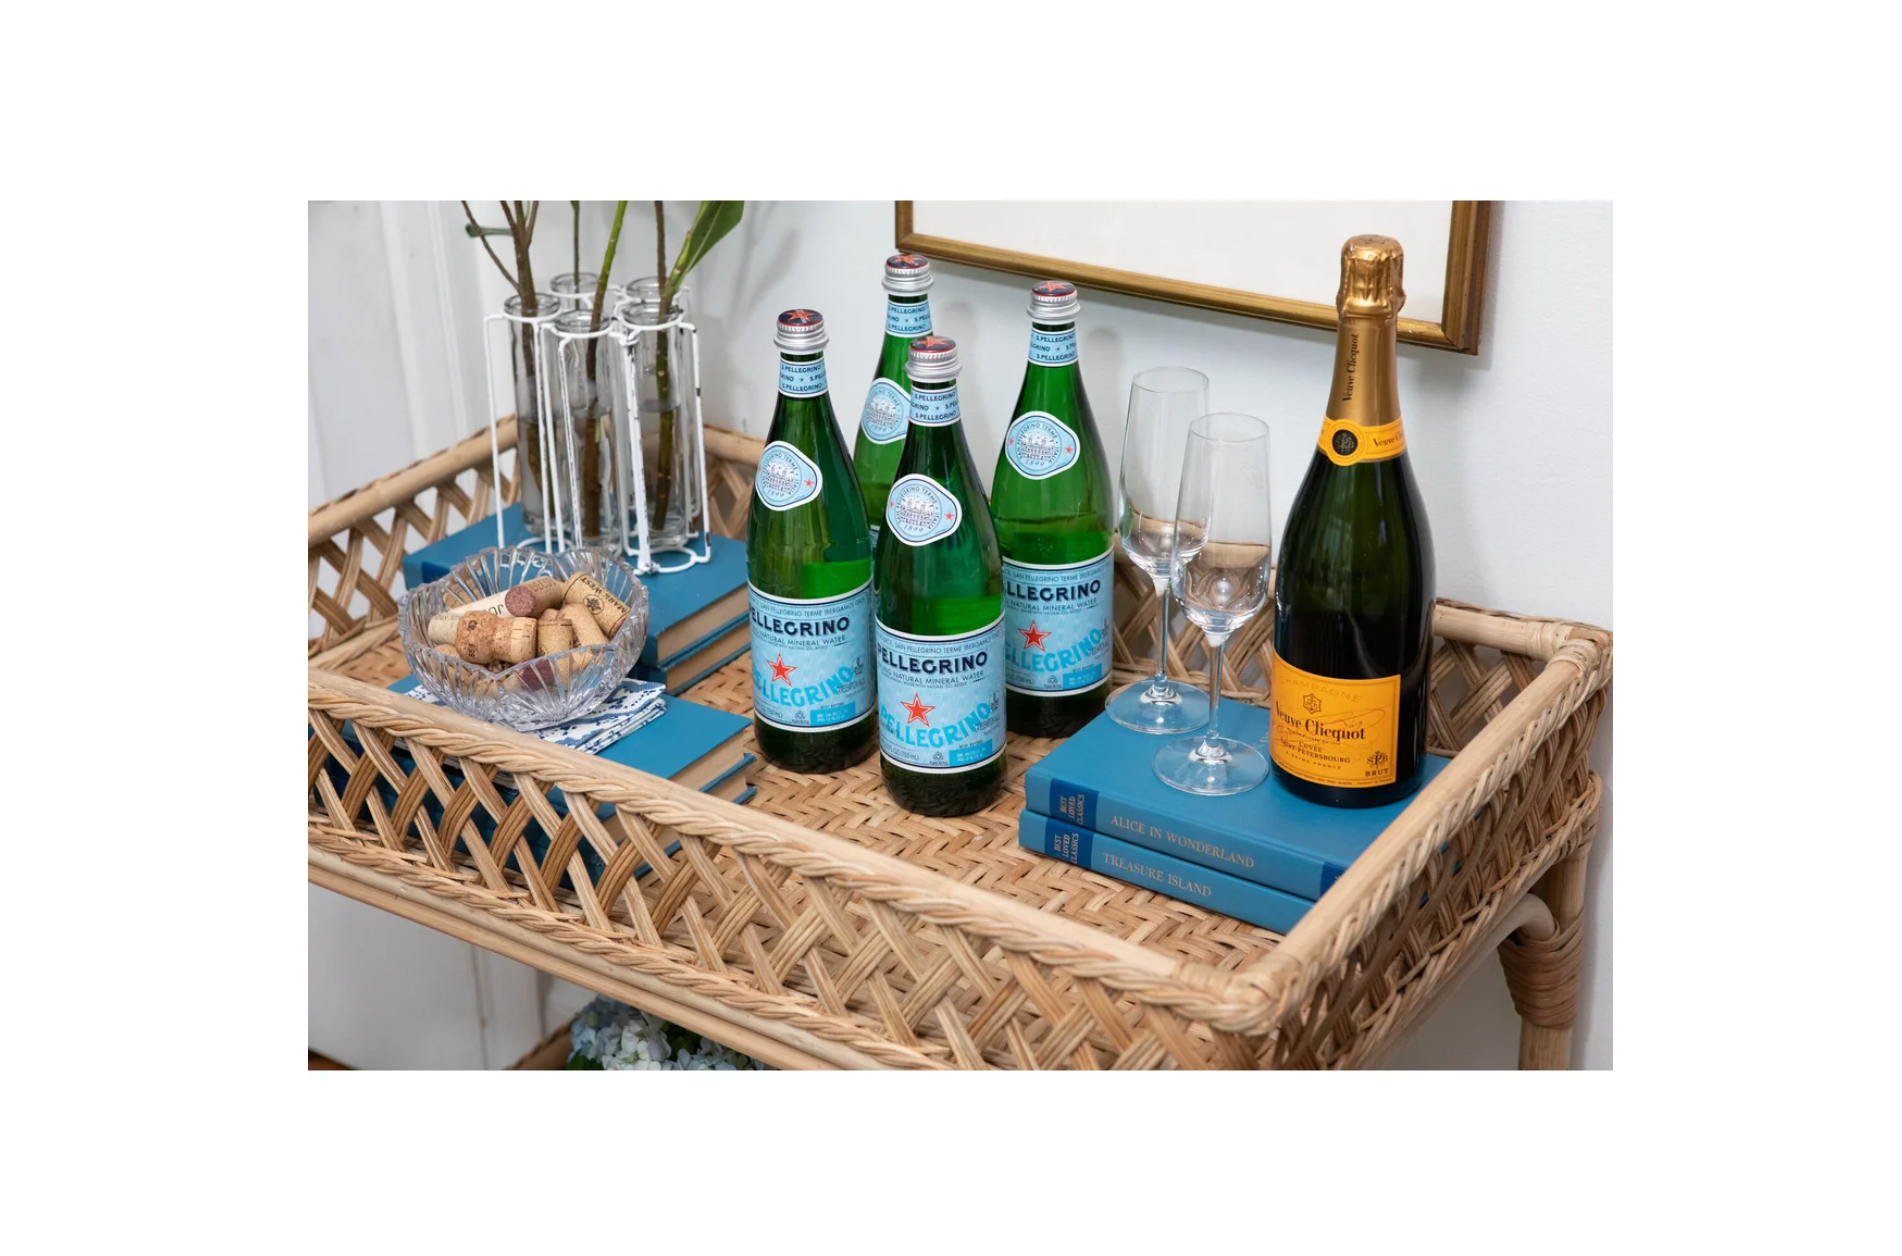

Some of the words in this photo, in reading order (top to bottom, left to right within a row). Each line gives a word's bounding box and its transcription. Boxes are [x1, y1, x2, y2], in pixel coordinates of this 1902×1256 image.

[1346, 333, 1360, 375] Clicquot
[1342, 375, 1355, 402] Veuve
[787, 639, 820, 647] MINERAL
[822, 634, 846, 645] WATER
[893, 671, 922, 683] NATURAL
[925, 677, 960, 685] MINERAL
[961, 669, 984, 682] WATER
[879, 702, 992, 749] PELLEGRINO
[1275, 700, 1302, 726] Veuve
[1305, 717, 1366, 742] Clicquot
[1365, 768, 1389, 777] BRUT
[1059, 795, 1068, 814] BEST
[1068, 795, 1078, 820] LOVED
[1077, 793, 1086, 826] CLASSICS
[1053, 833, 1062, 852] BEST
[1061, 833, 1071, 859] LOVED
[1071, 832, 1080, 866] CLASSICS
[1109, 814, 1146, 835] ALICE
[1149, 825, 1163, 840] IN
[1166, 831, 1255, 869] WONDERLAND
[1102, 852, 1165, 883] TREASURE
[1167, 873, 1212, 898] ISLAND
